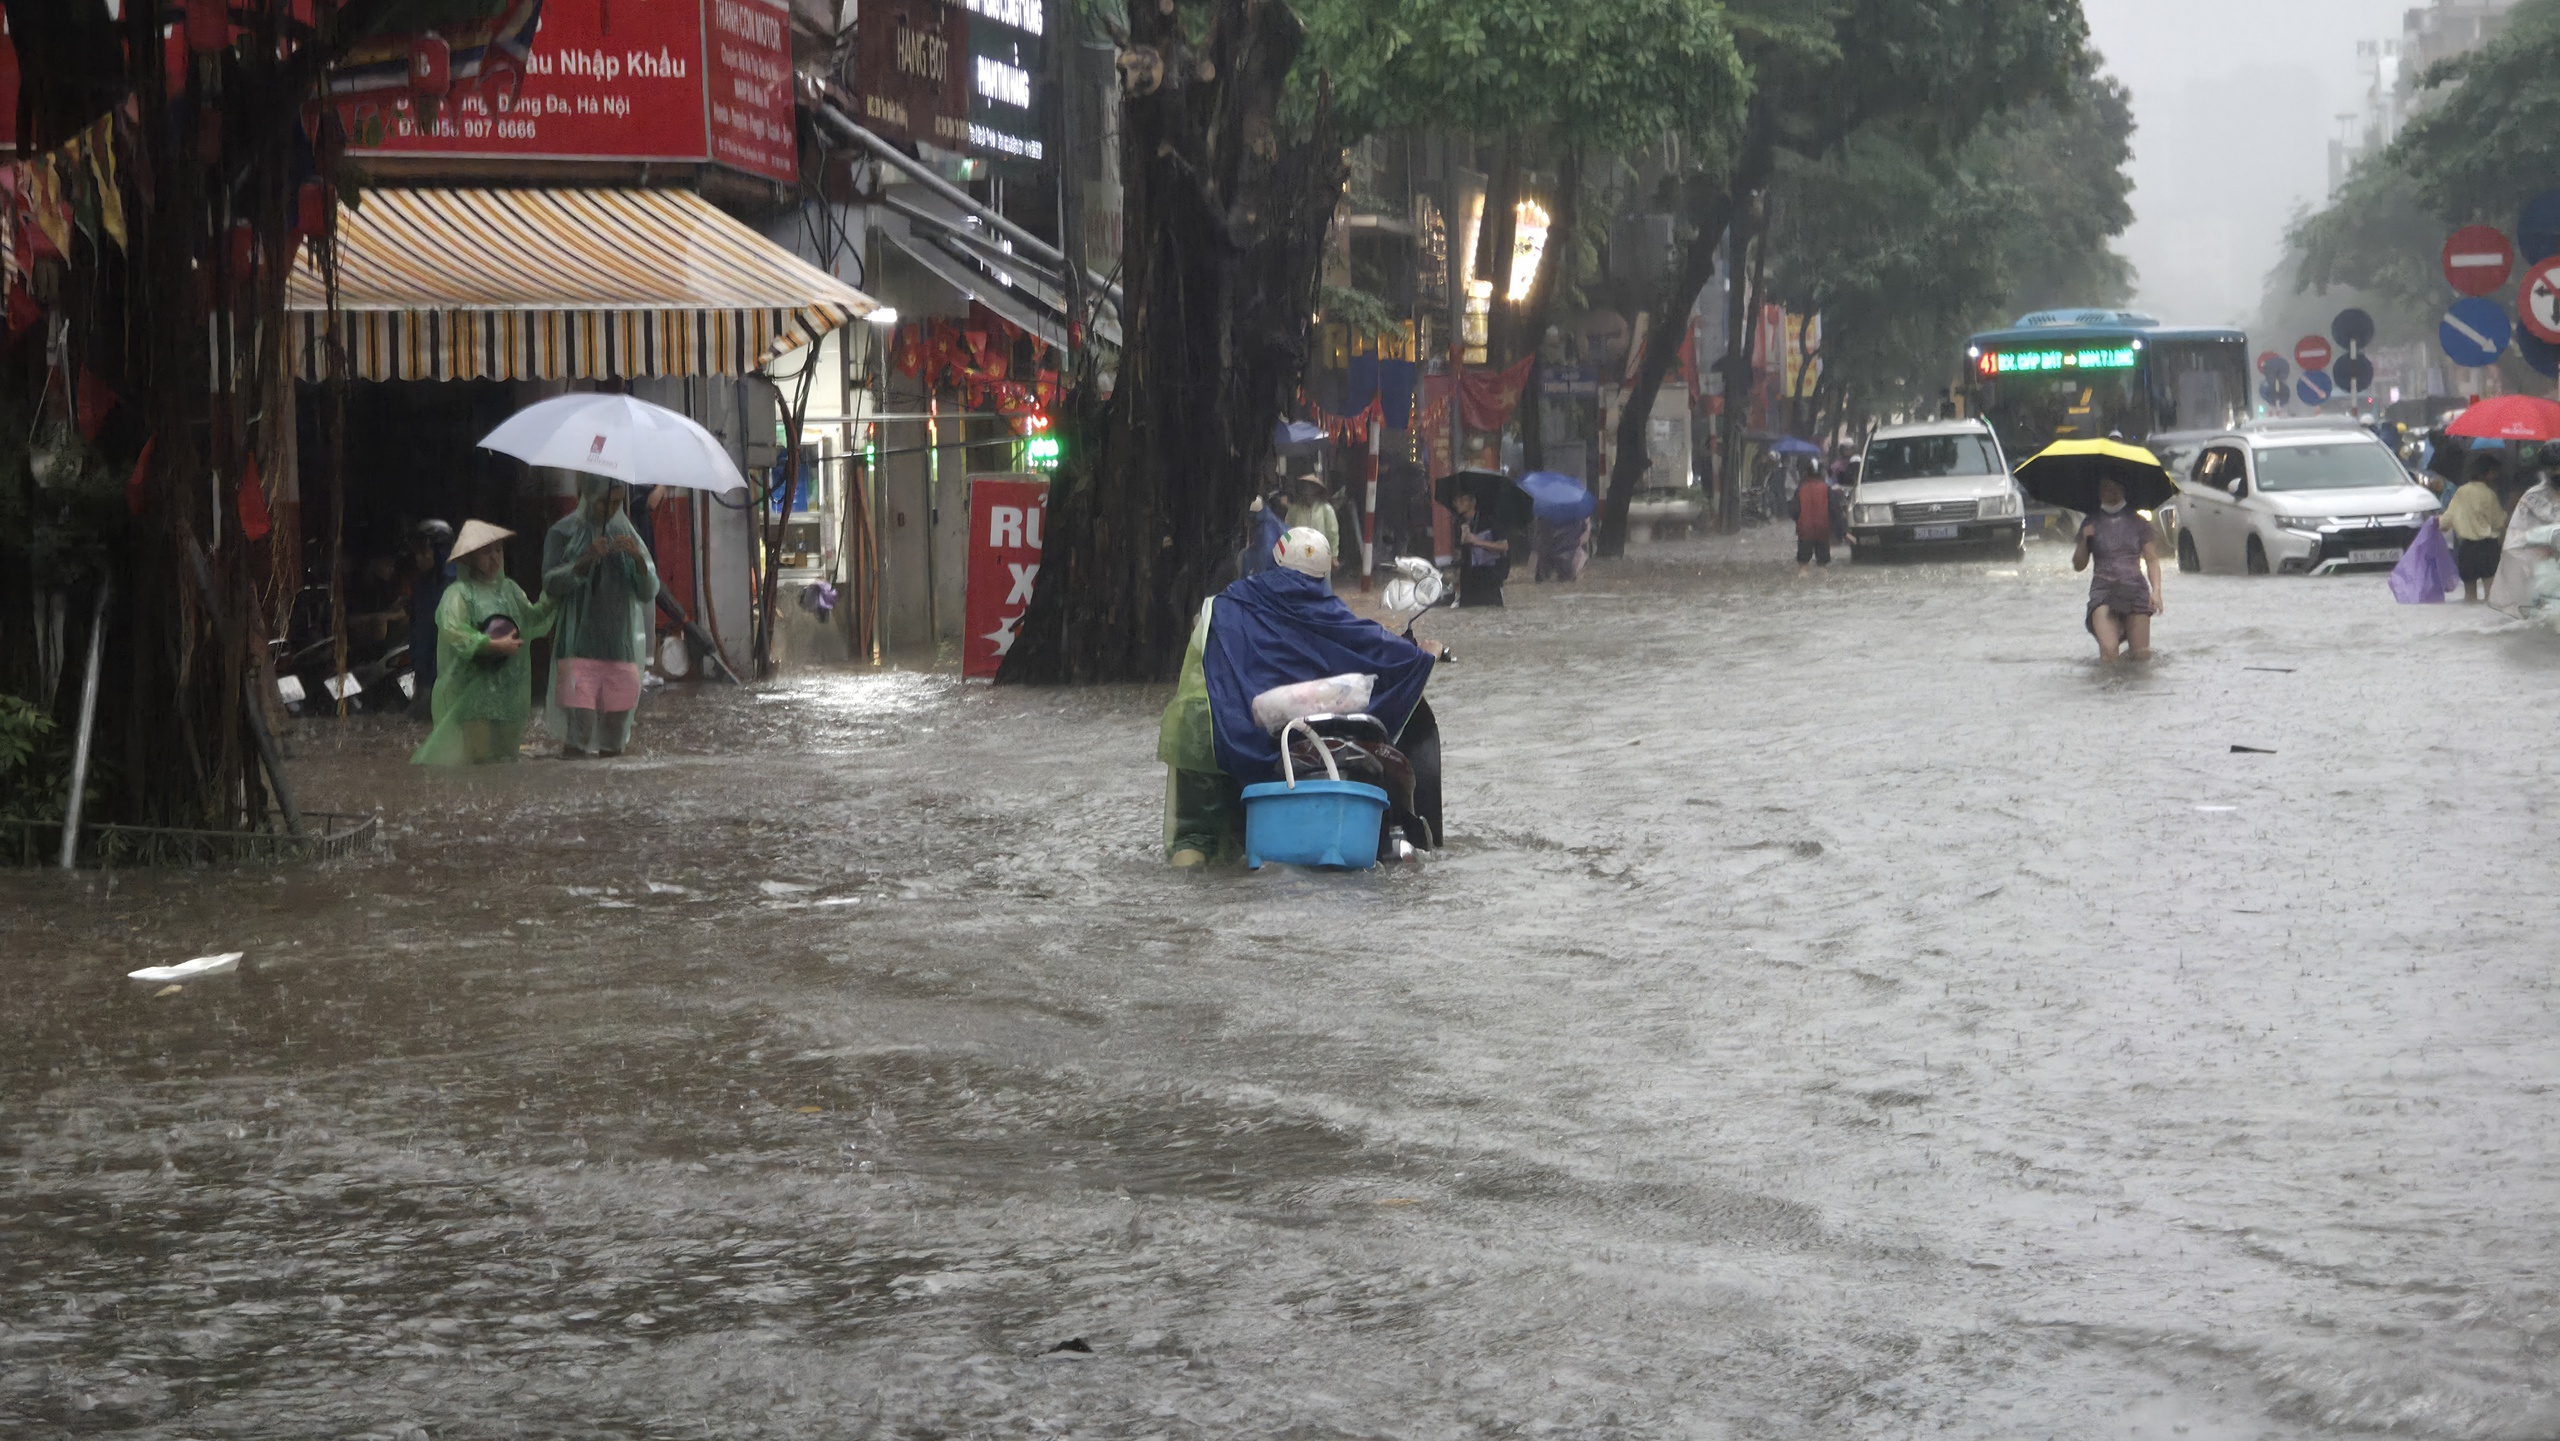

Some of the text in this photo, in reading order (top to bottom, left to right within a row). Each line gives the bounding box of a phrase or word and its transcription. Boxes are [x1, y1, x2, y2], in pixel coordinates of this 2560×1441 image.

[755, 11, 782, 53] MOTOR
[560, 48, 620, 82] Nhập
[627, 45, 686, 78] Khẩu
[577, 94, 599, 115] Hà
[603, 95, 630, 119] Nội
[464, 119, 492, 138] 907
[1980, 352, 1997, 374] 41
